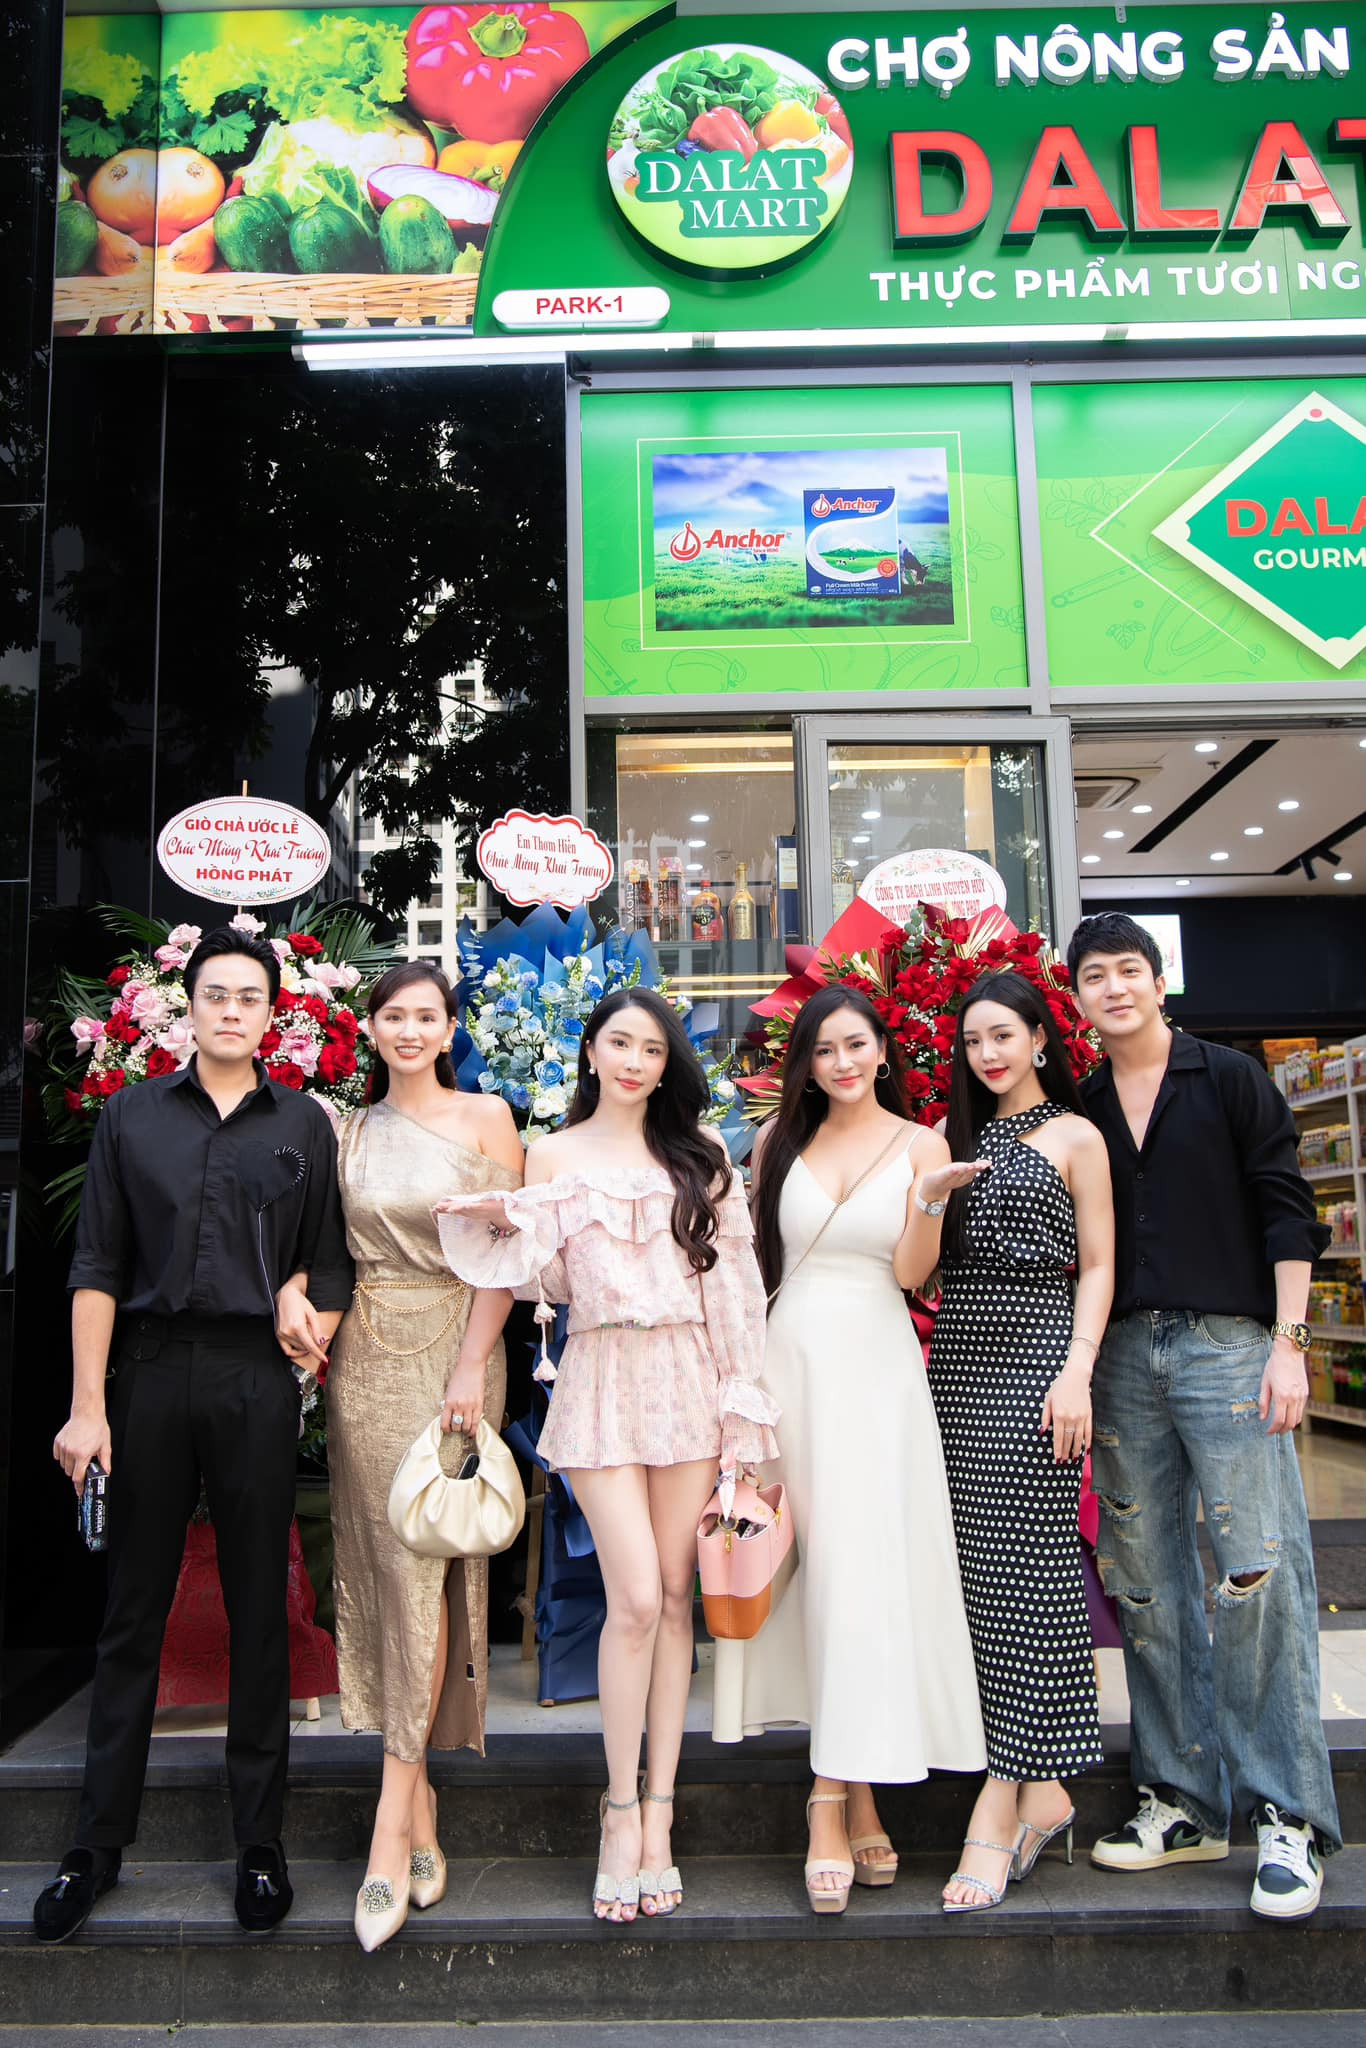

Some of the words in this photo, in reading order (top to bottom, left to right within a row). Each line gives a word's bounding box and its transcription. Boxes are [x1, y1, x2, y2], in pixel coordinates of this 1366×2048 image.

[827, 26, 971, 92] CHỢ
[995, 23, 1185, 83] NÔNG
[1210, 11, 1351, 78] SẢN
[645, 157, 817, 194] DALAT
[887, 116, 1366, 238] DALA
[690, 197, 818, 229] MART
[869, 264, 997, 309] THỰC
[1015, 256, 1150, 299] PHẨM
[1167, 260, 1279, 296] TƯƠI
[1298, 260, 1366, 292] NG
[536, 295, 623, 315] PARK-1
[831, 496, 879, 511] Anchor
[702, 527, 785, 549] Anchor
[185, 815, 211, 831] GIÒ
[214, 815, 245, 832] CHẢ
[248, 817, 279, 834] ƯỚC
[282, 817, 299, 834] LỄ
[517, 833, 531, 849] Em
[196, 863, 245, 881] HỒNG
[248, 867, 293, 883] PHÁT
[626, 882, 634, 924] CHOYA
